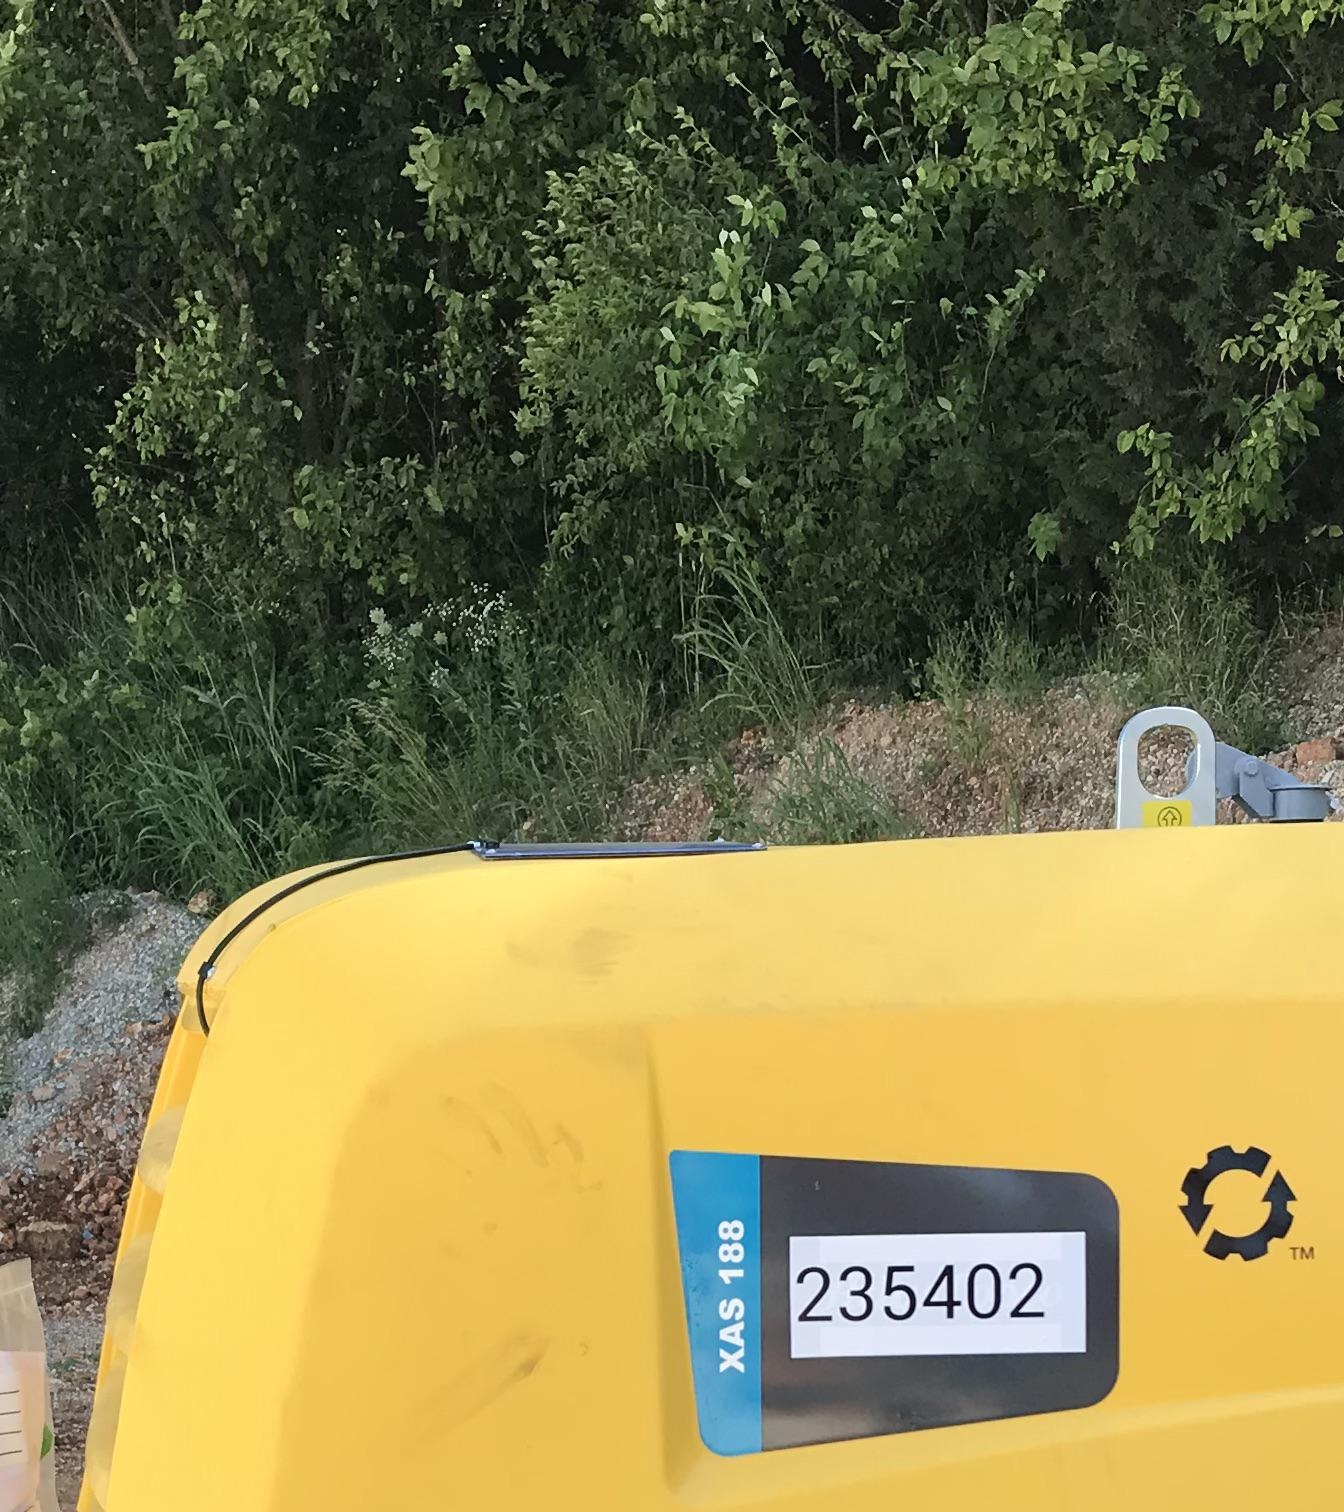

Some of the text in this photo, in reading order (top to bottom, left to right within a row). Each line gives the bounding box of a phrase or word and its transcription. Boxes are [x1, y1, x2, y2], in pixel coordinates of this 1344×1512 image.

[1289, 1246, 1315, 1261] TM
[717, 1219, 746, 1374] XAS 188
[795, 1261, 1046, 1323] 235402
